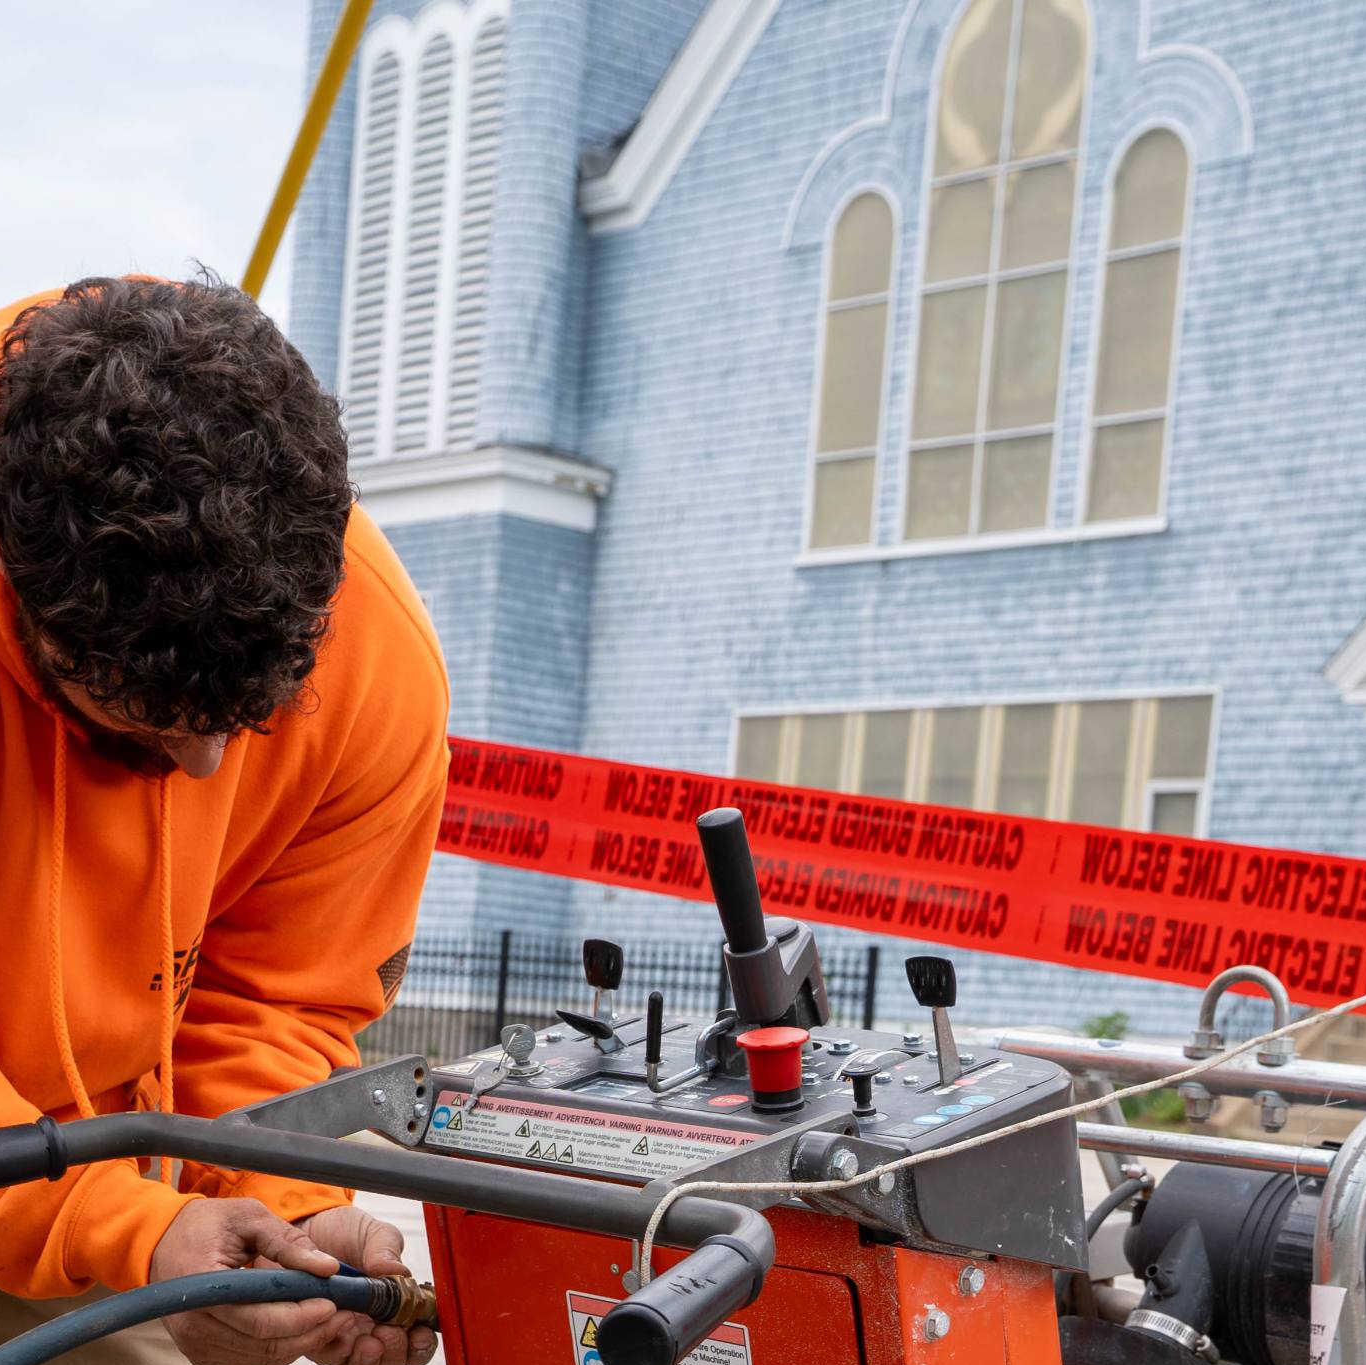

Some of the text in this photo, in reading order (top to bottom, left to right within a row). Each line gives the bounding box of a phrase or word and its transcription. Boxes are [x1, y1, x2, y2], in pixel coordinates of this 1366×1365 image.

[496, 1104, 554, 1119] AVERTISSEMENT
[555, 1112, 606, 1127] ADVERTENCIA
[610, 1120, 642, 1132] VARNING
[645, 1124, 684, 1138] WARNUNG
[686, 1130, 736, 1146] AVVERTENZA
[710, 1344, 745, 1360] Operation
